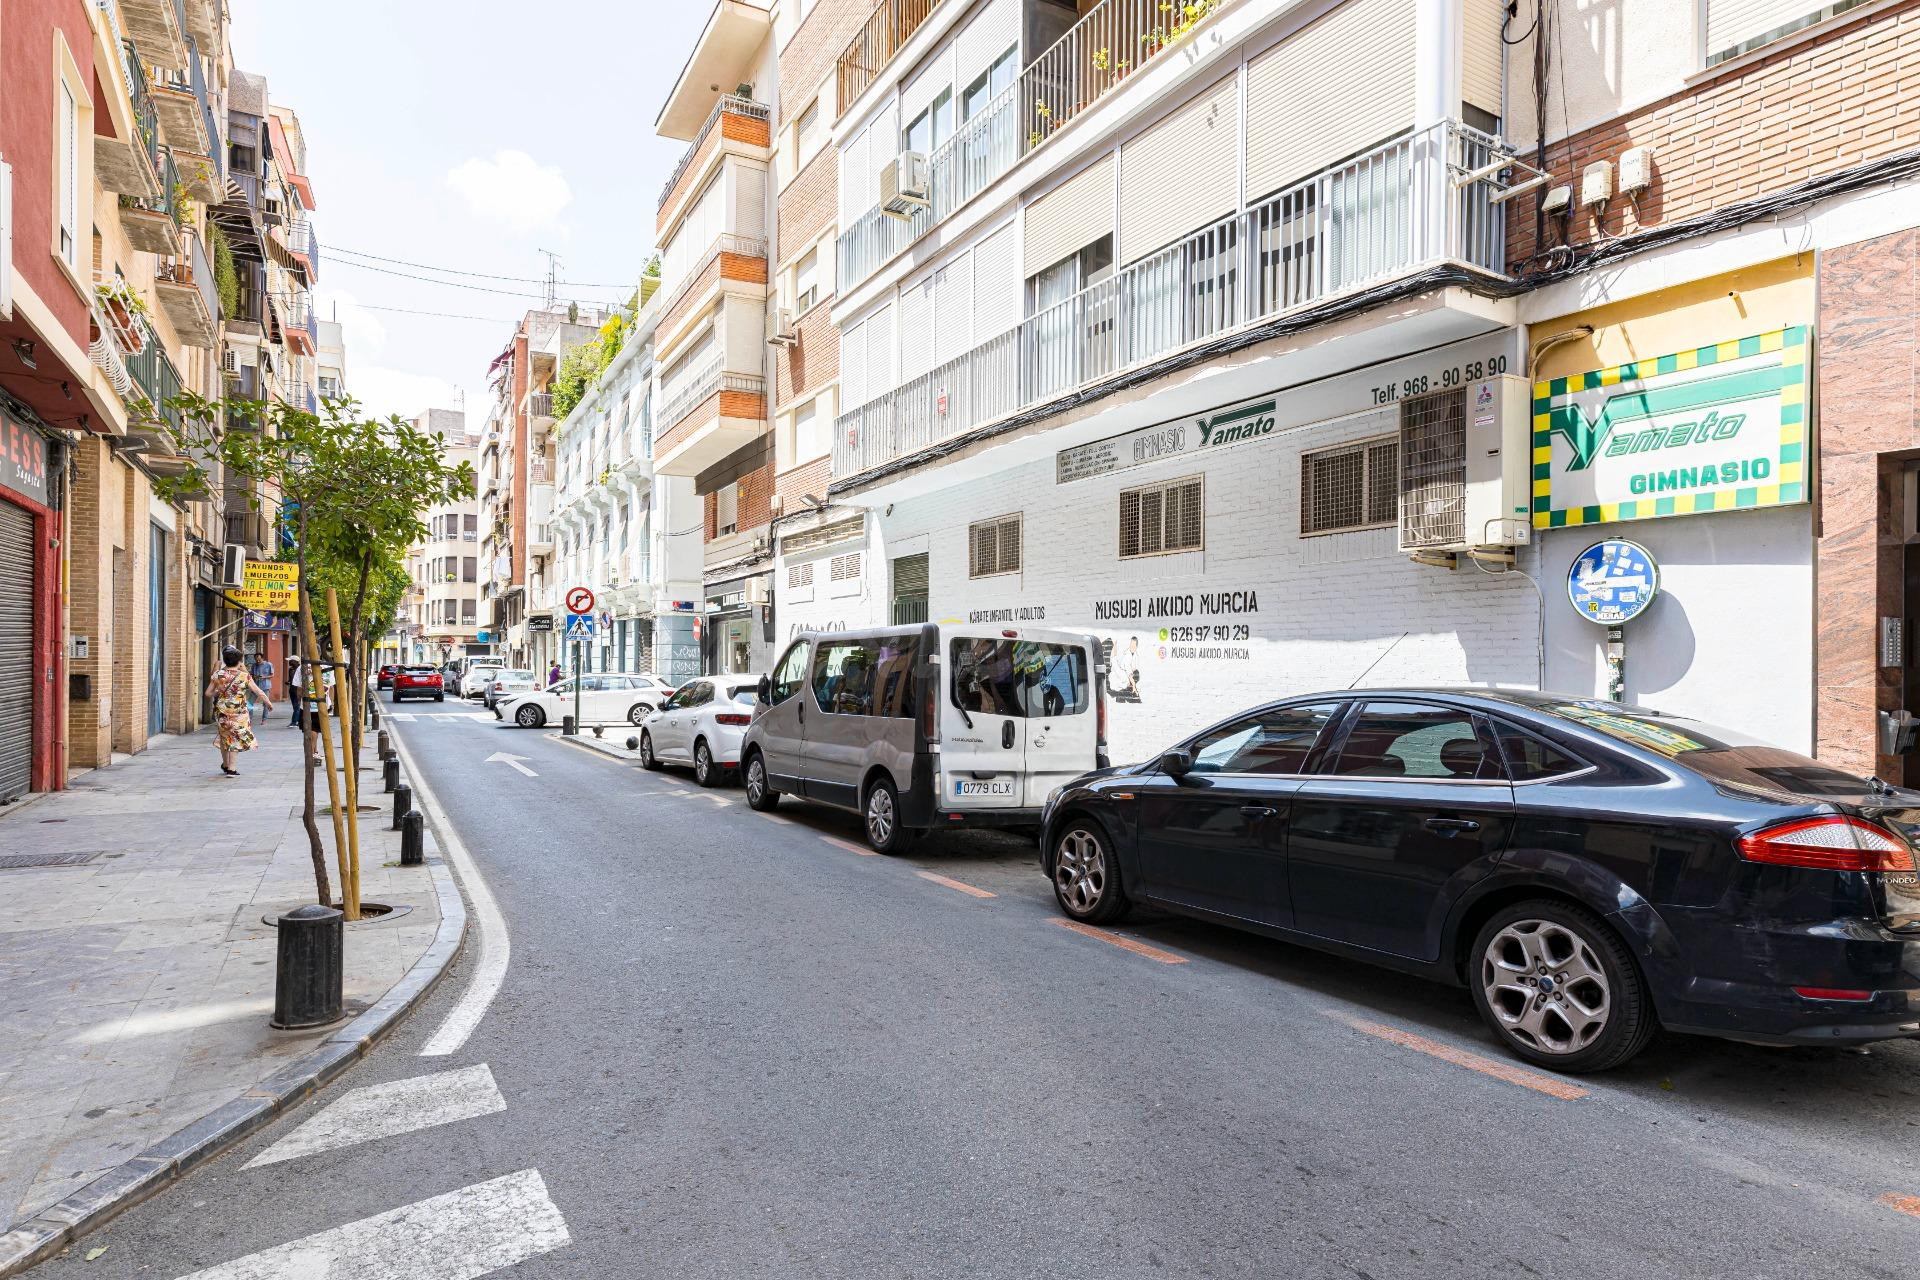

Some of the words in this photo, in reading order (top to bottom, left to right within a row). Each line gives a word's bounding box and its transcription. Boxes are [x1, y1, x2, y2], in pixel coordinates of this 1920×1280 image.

[1371, 383, 1399, 405] Telf.
[1403, 376, 1428, 397] 968
[1442, 367, 1460, 388] 90
[1465, 361, 1482, 382] 58
[1488, 355, 1507, 376] 90
[1134, 426, 1186, 461] GIMNASIO
[1196, 400, 1277, 447] Yamato
[1550, 390, 1750, 472] Yamato
[1629, 458, 1771, 495] GIMNASIO
[990, 608, 1013, 622] INFANTIL
[1014, 608, 1019, 620] Y
[1020, 606, 1045, 620] ADULTOS
[1095, 599, 1142, 620] MUSUBI
[1147, 595, 1194, 617] AIKIDO
[1200, 591, 1258, 615] MURCIA
[1171, 627, 1193, 642] 626
[1195, 626, 1211, 642] 97
[1213, 625, 1230, 641] 90
[1232, 624, 1250, 641] 29
[963, 783, 989, 794] 0779
[992, 783, 1011, 794] CLX
[1876, 877, 1916, 885] MONDEO
